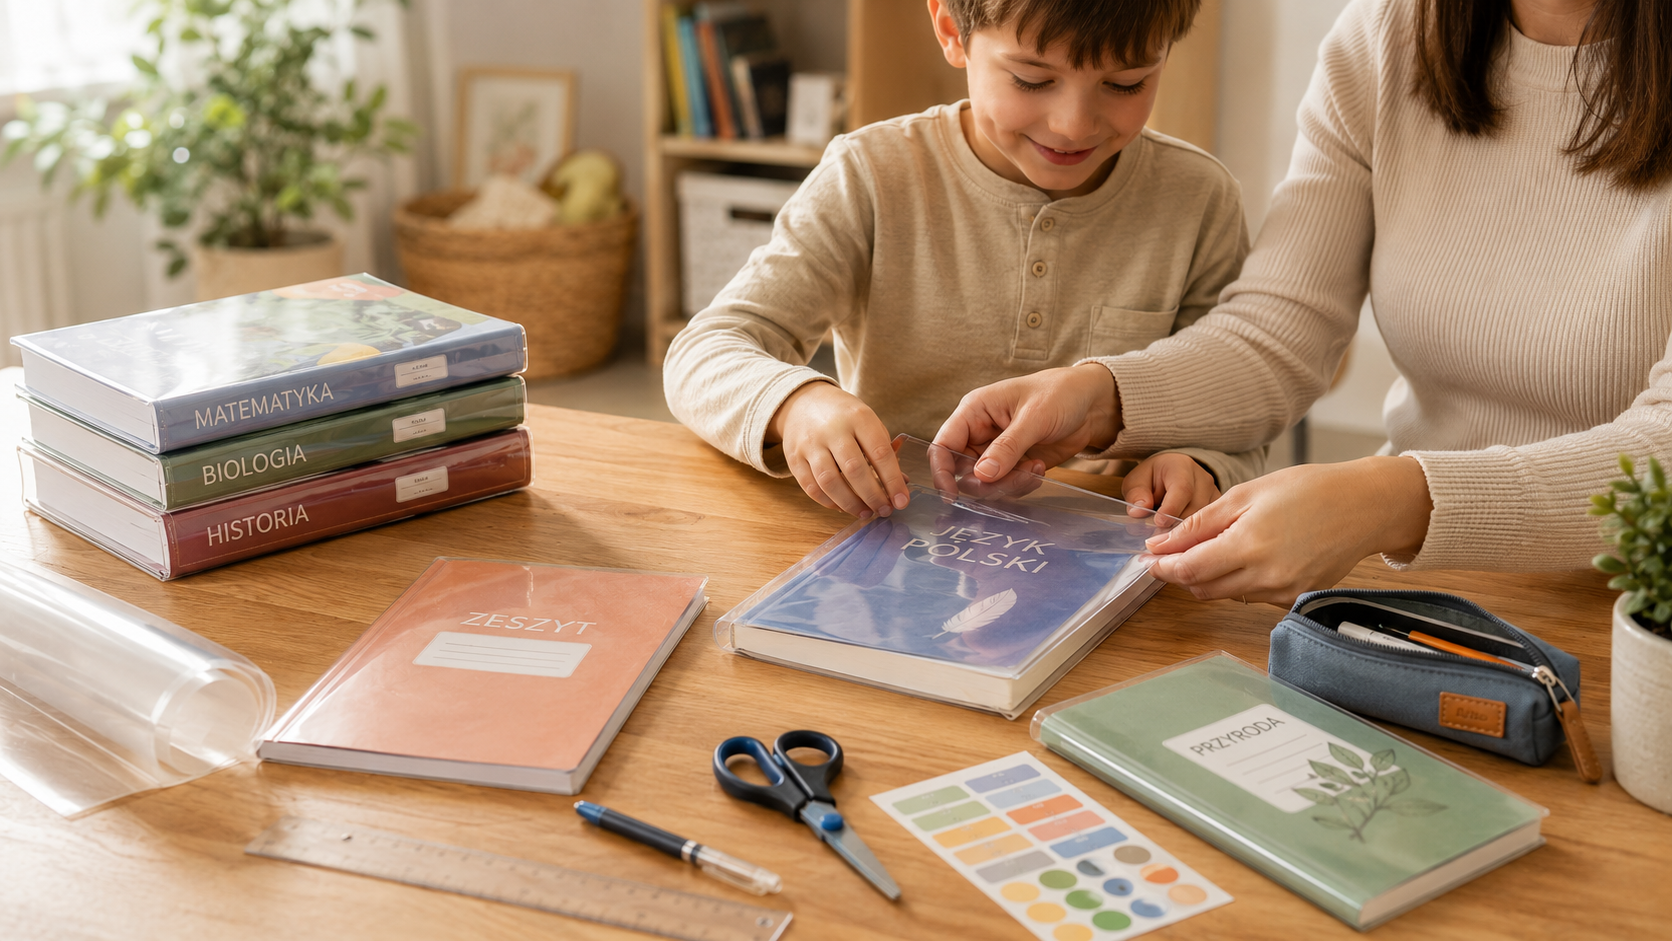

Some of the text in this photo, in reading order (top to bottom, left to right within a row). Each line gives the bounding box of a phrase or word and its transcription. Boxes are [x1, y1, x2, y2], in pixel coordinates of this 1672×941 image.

[194, 382, 334, 430] MATEMATYKA
[202, 444, 307, 486] BIOLOGIA
[206, 504, 310, 547] HISTORIA
[930, 526, 1056, 555] JĘZYK
[901, 538, 1049, 574] POLSKI
[460, 611, 597, 635] ZESZYT
[1190, 717, 1286, 757] PRZYRODA
